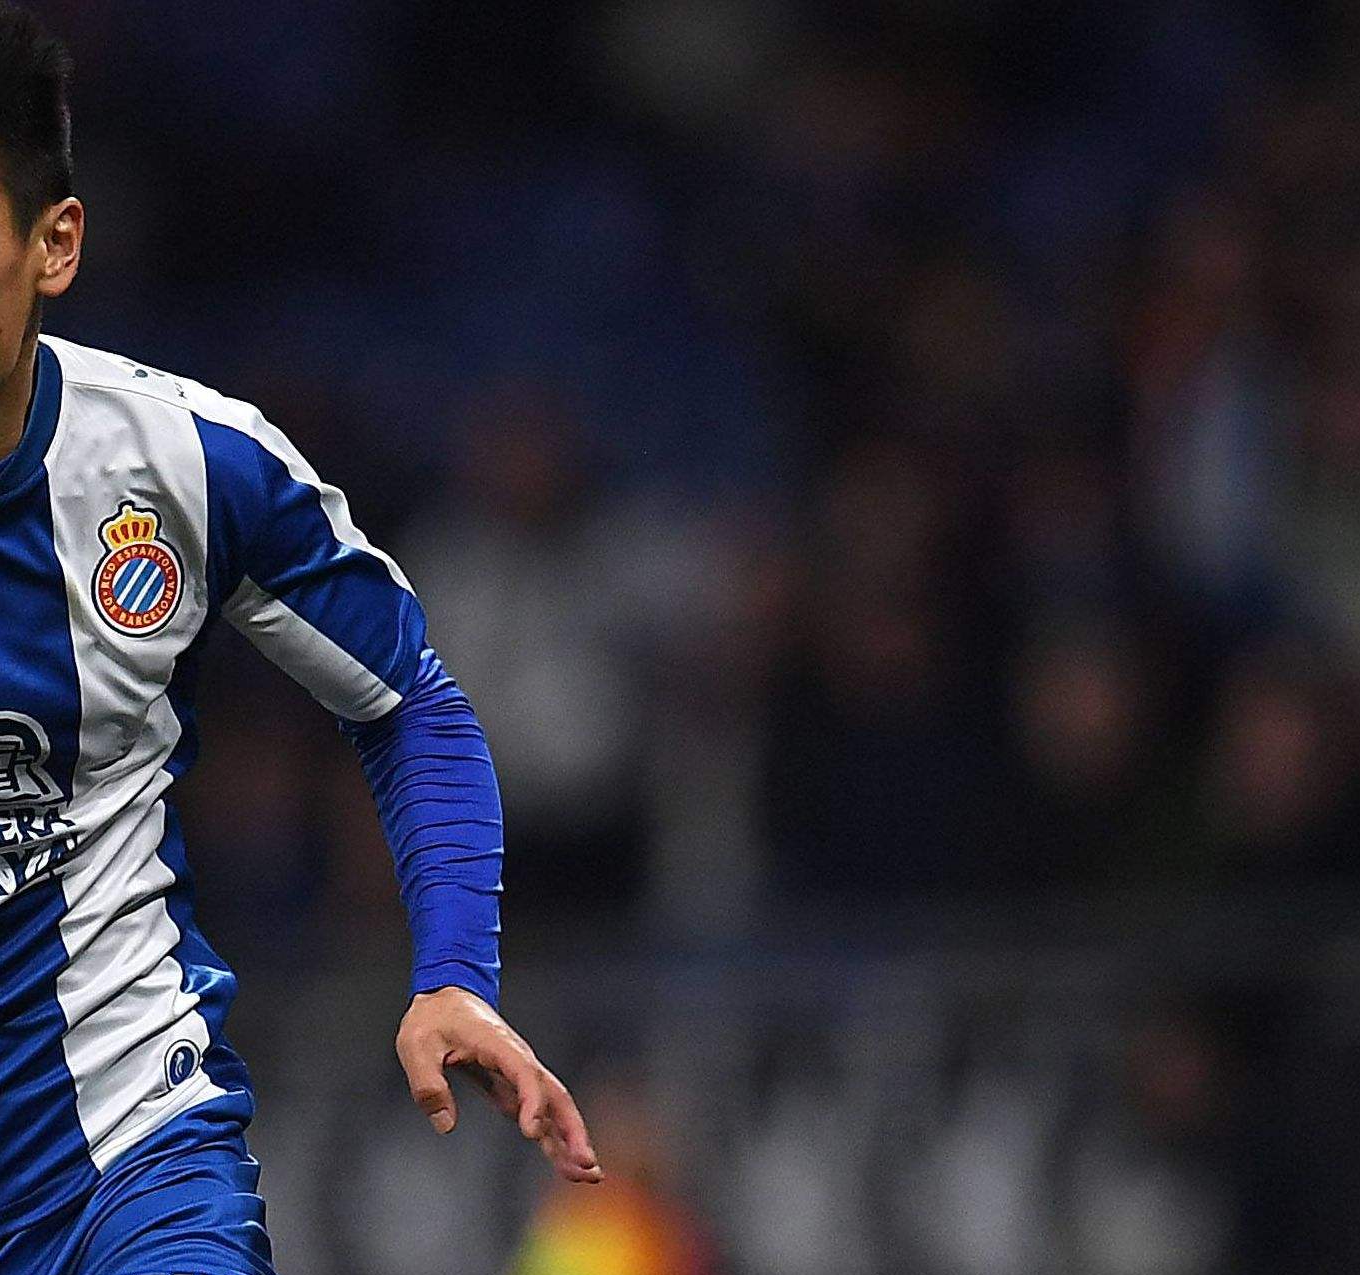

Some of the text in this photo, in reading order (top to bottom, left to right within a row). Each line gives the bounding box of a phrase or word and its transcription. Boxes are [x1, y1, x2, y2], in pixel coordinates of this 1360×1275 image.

[101, 546, 173, 588] RCD ESPANYOL
[119, 581, 175, 626] BARCELONA
